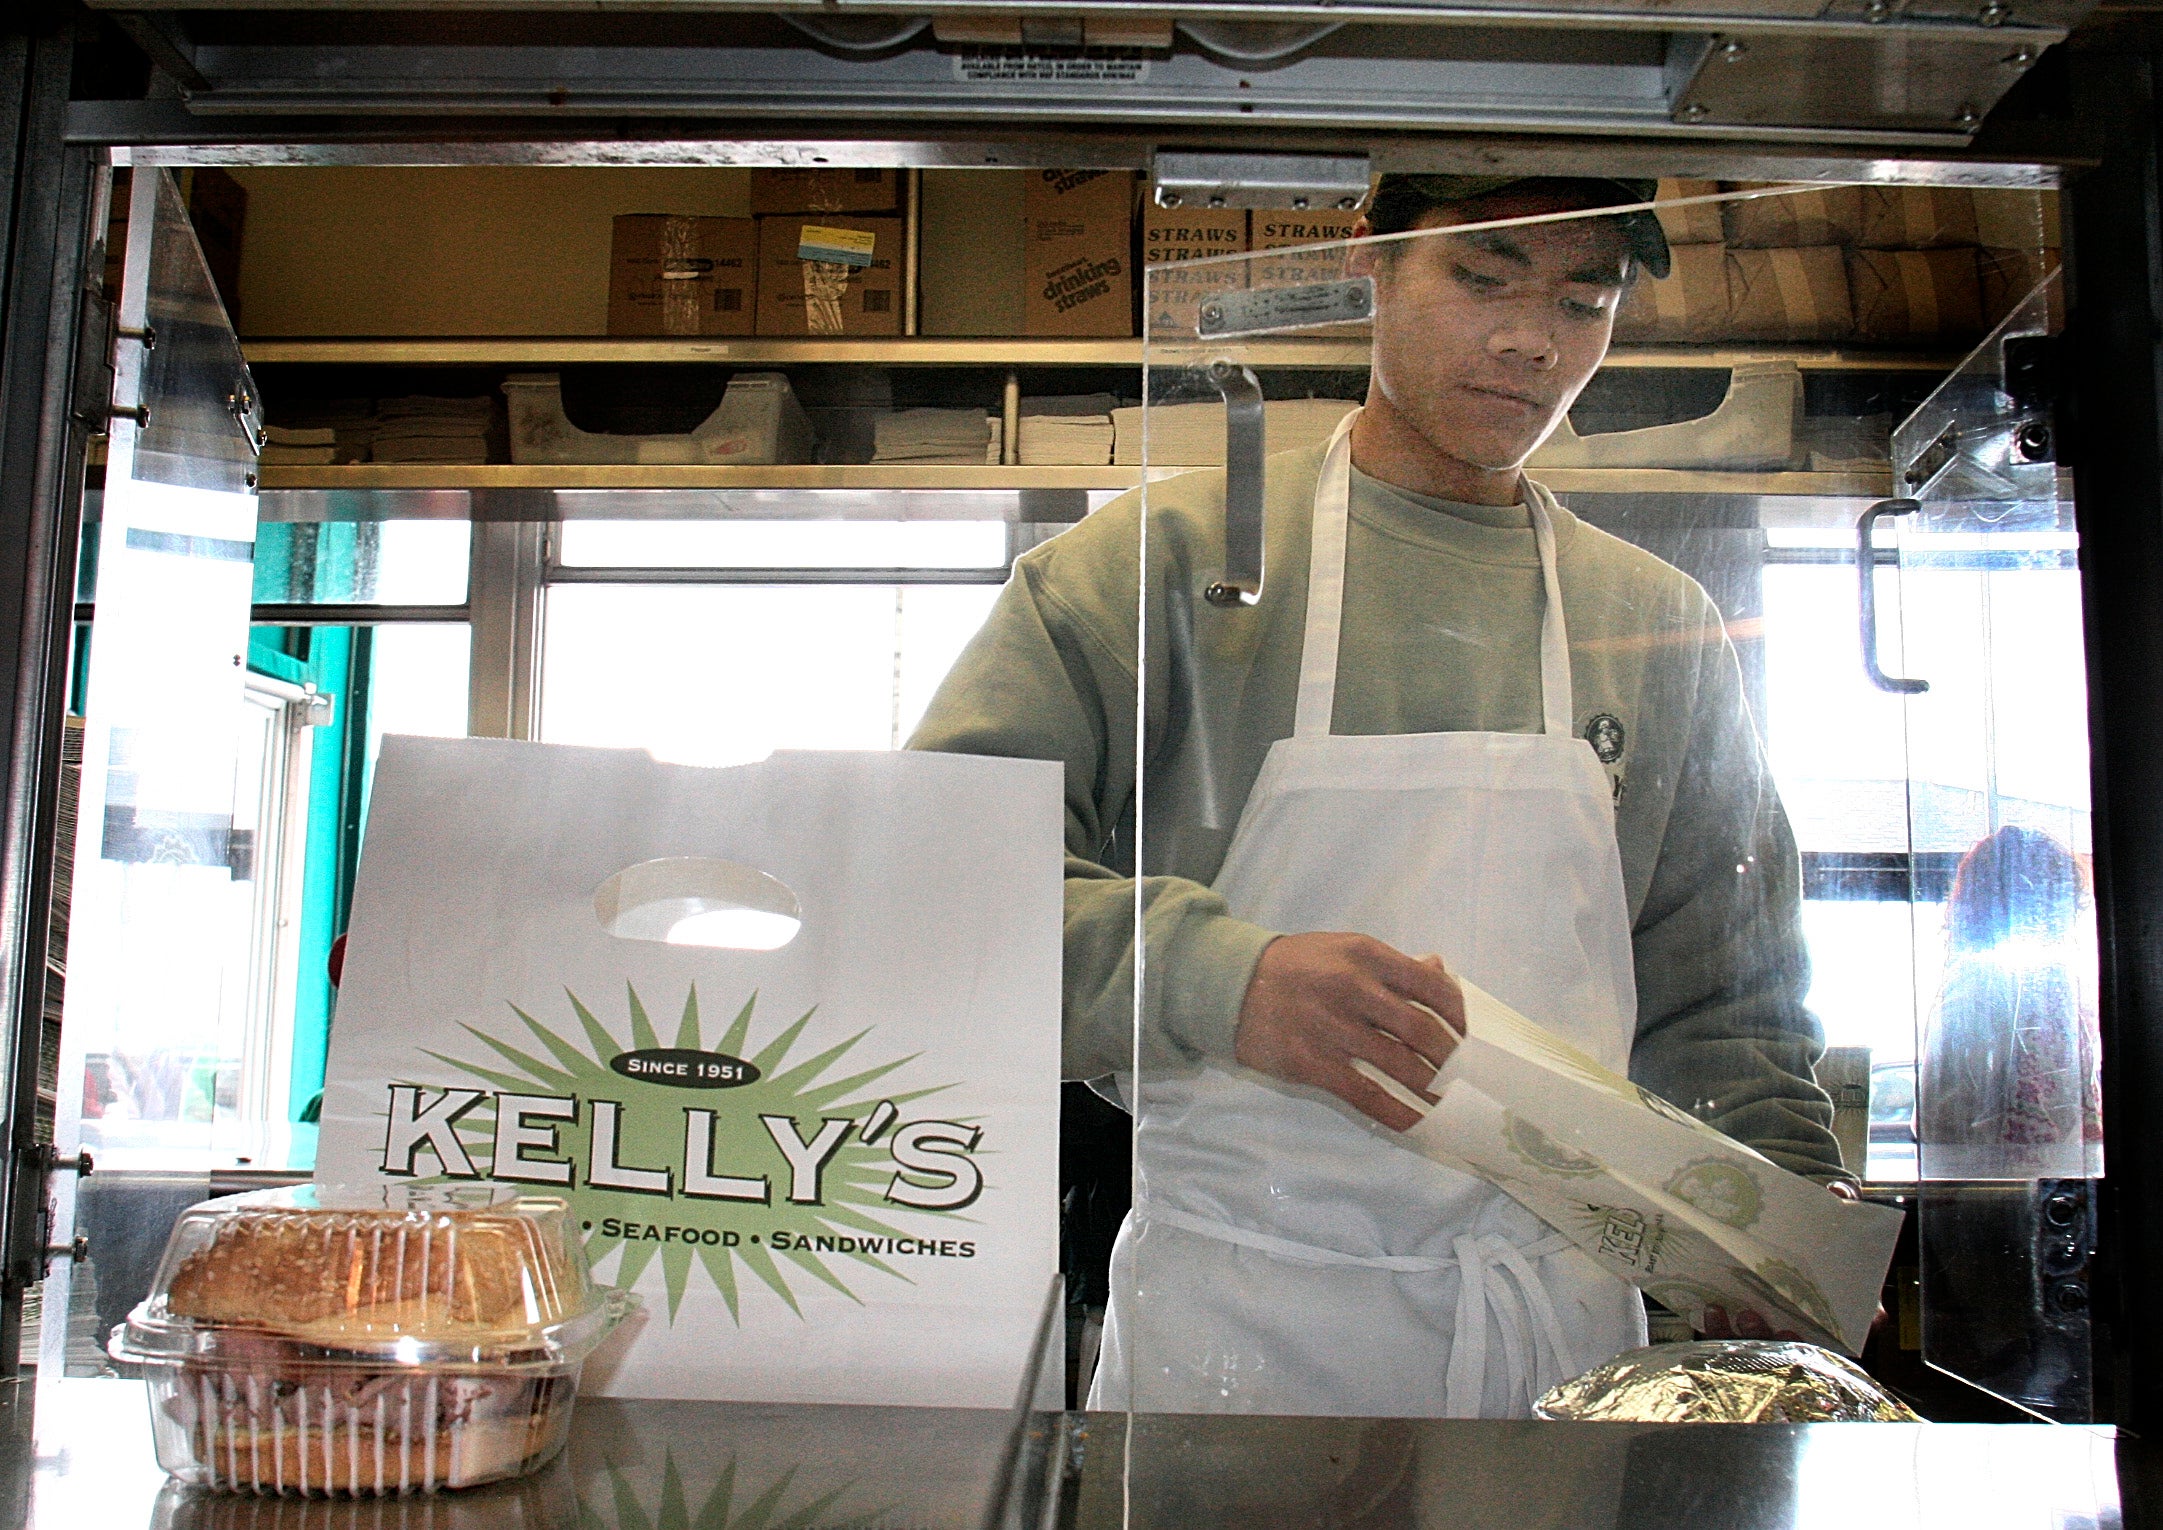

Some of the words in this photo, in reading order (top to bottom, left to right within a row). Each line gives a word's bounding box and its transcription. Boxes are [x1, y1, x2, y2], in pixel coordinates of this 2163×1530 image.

[1147, 228, 1238, 242] STRAWS
[1263, 223, 1353, 239] STRAWS
[1043, 258, 1122, 300] drinking
[1149, 269, 1237, 284] STRAWS
[1055, 280, 1110, 313] straws
[697, 1063, 743, 1080] 1951
[379, 1082, 986, 1211] KELLY'S
